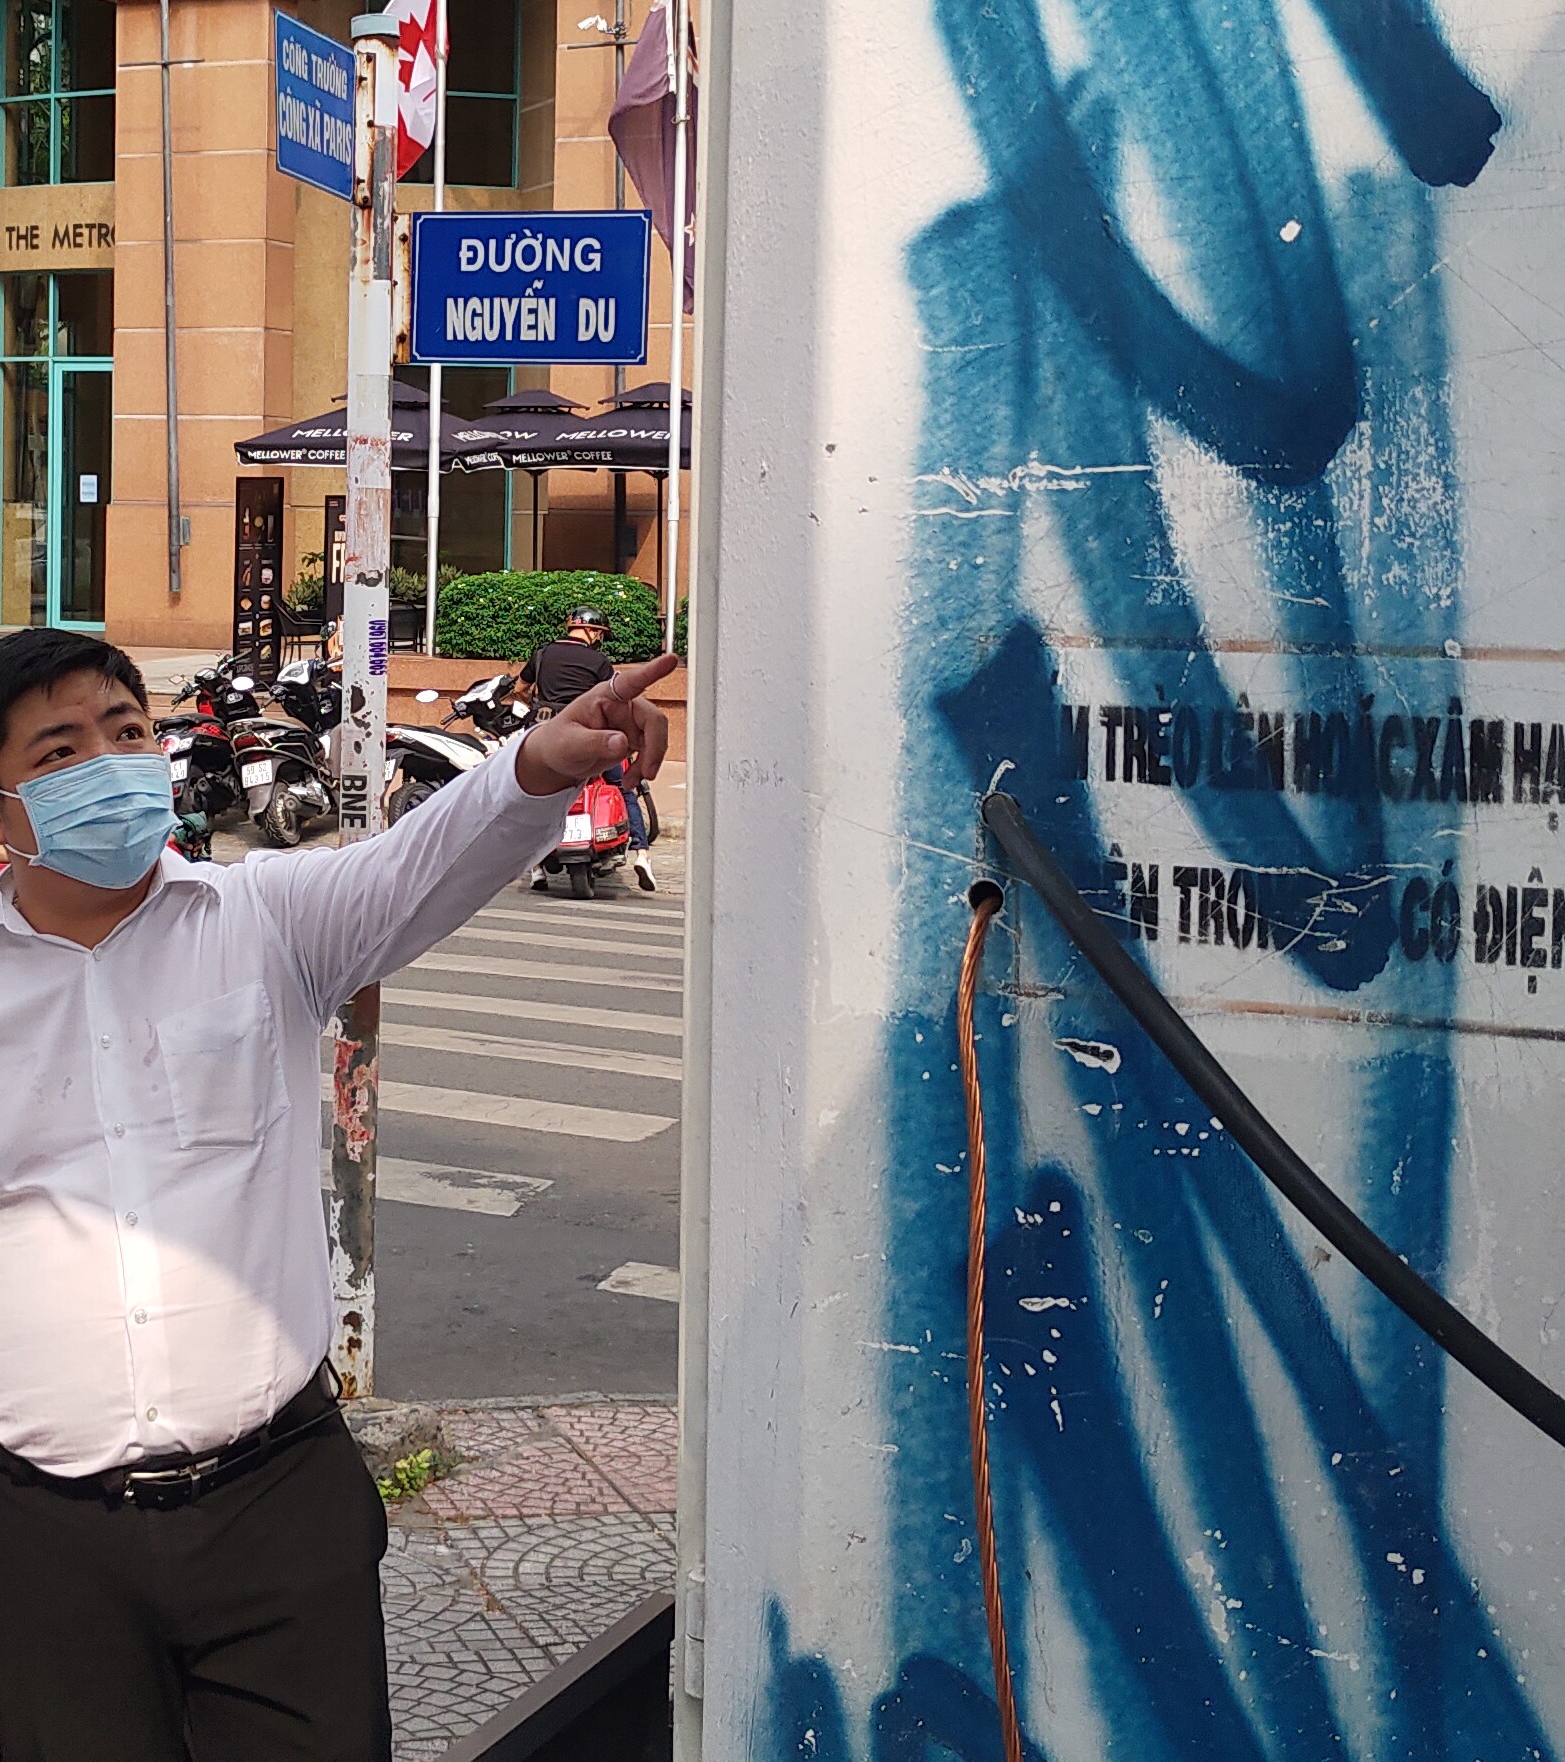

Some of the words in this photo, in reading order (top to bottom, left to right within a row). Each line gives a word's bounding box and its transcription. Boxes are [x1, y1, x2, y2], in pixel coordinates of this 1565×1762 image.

[283, 36, 308, 82] CÔNG
[311, 53, 348, 101] TRƯỜNG
[279, 86, 307, 146] CÔNG
[323, 112, 352, 166] PARIS
[5, 224, 40, 251] THE
[52, 222, 115, 250] METR
[459, 229, 602, 273] ĐƯỜNG
[446, 279, 556, 342] NGUYỄN
[577, 297, 616, 342] DU
[292, 427, 414, 442] MELLER
[307, 449, 346, 460] COFFEE
[573, 450, 613, 461] COFFEE
[1100, 682, 1200, 790] TRÈO
[1411, 697, 1505, 805] XÂM
[341, 773, 368, 829] BNE
[1399, 858, 1462, 964] CÓ
